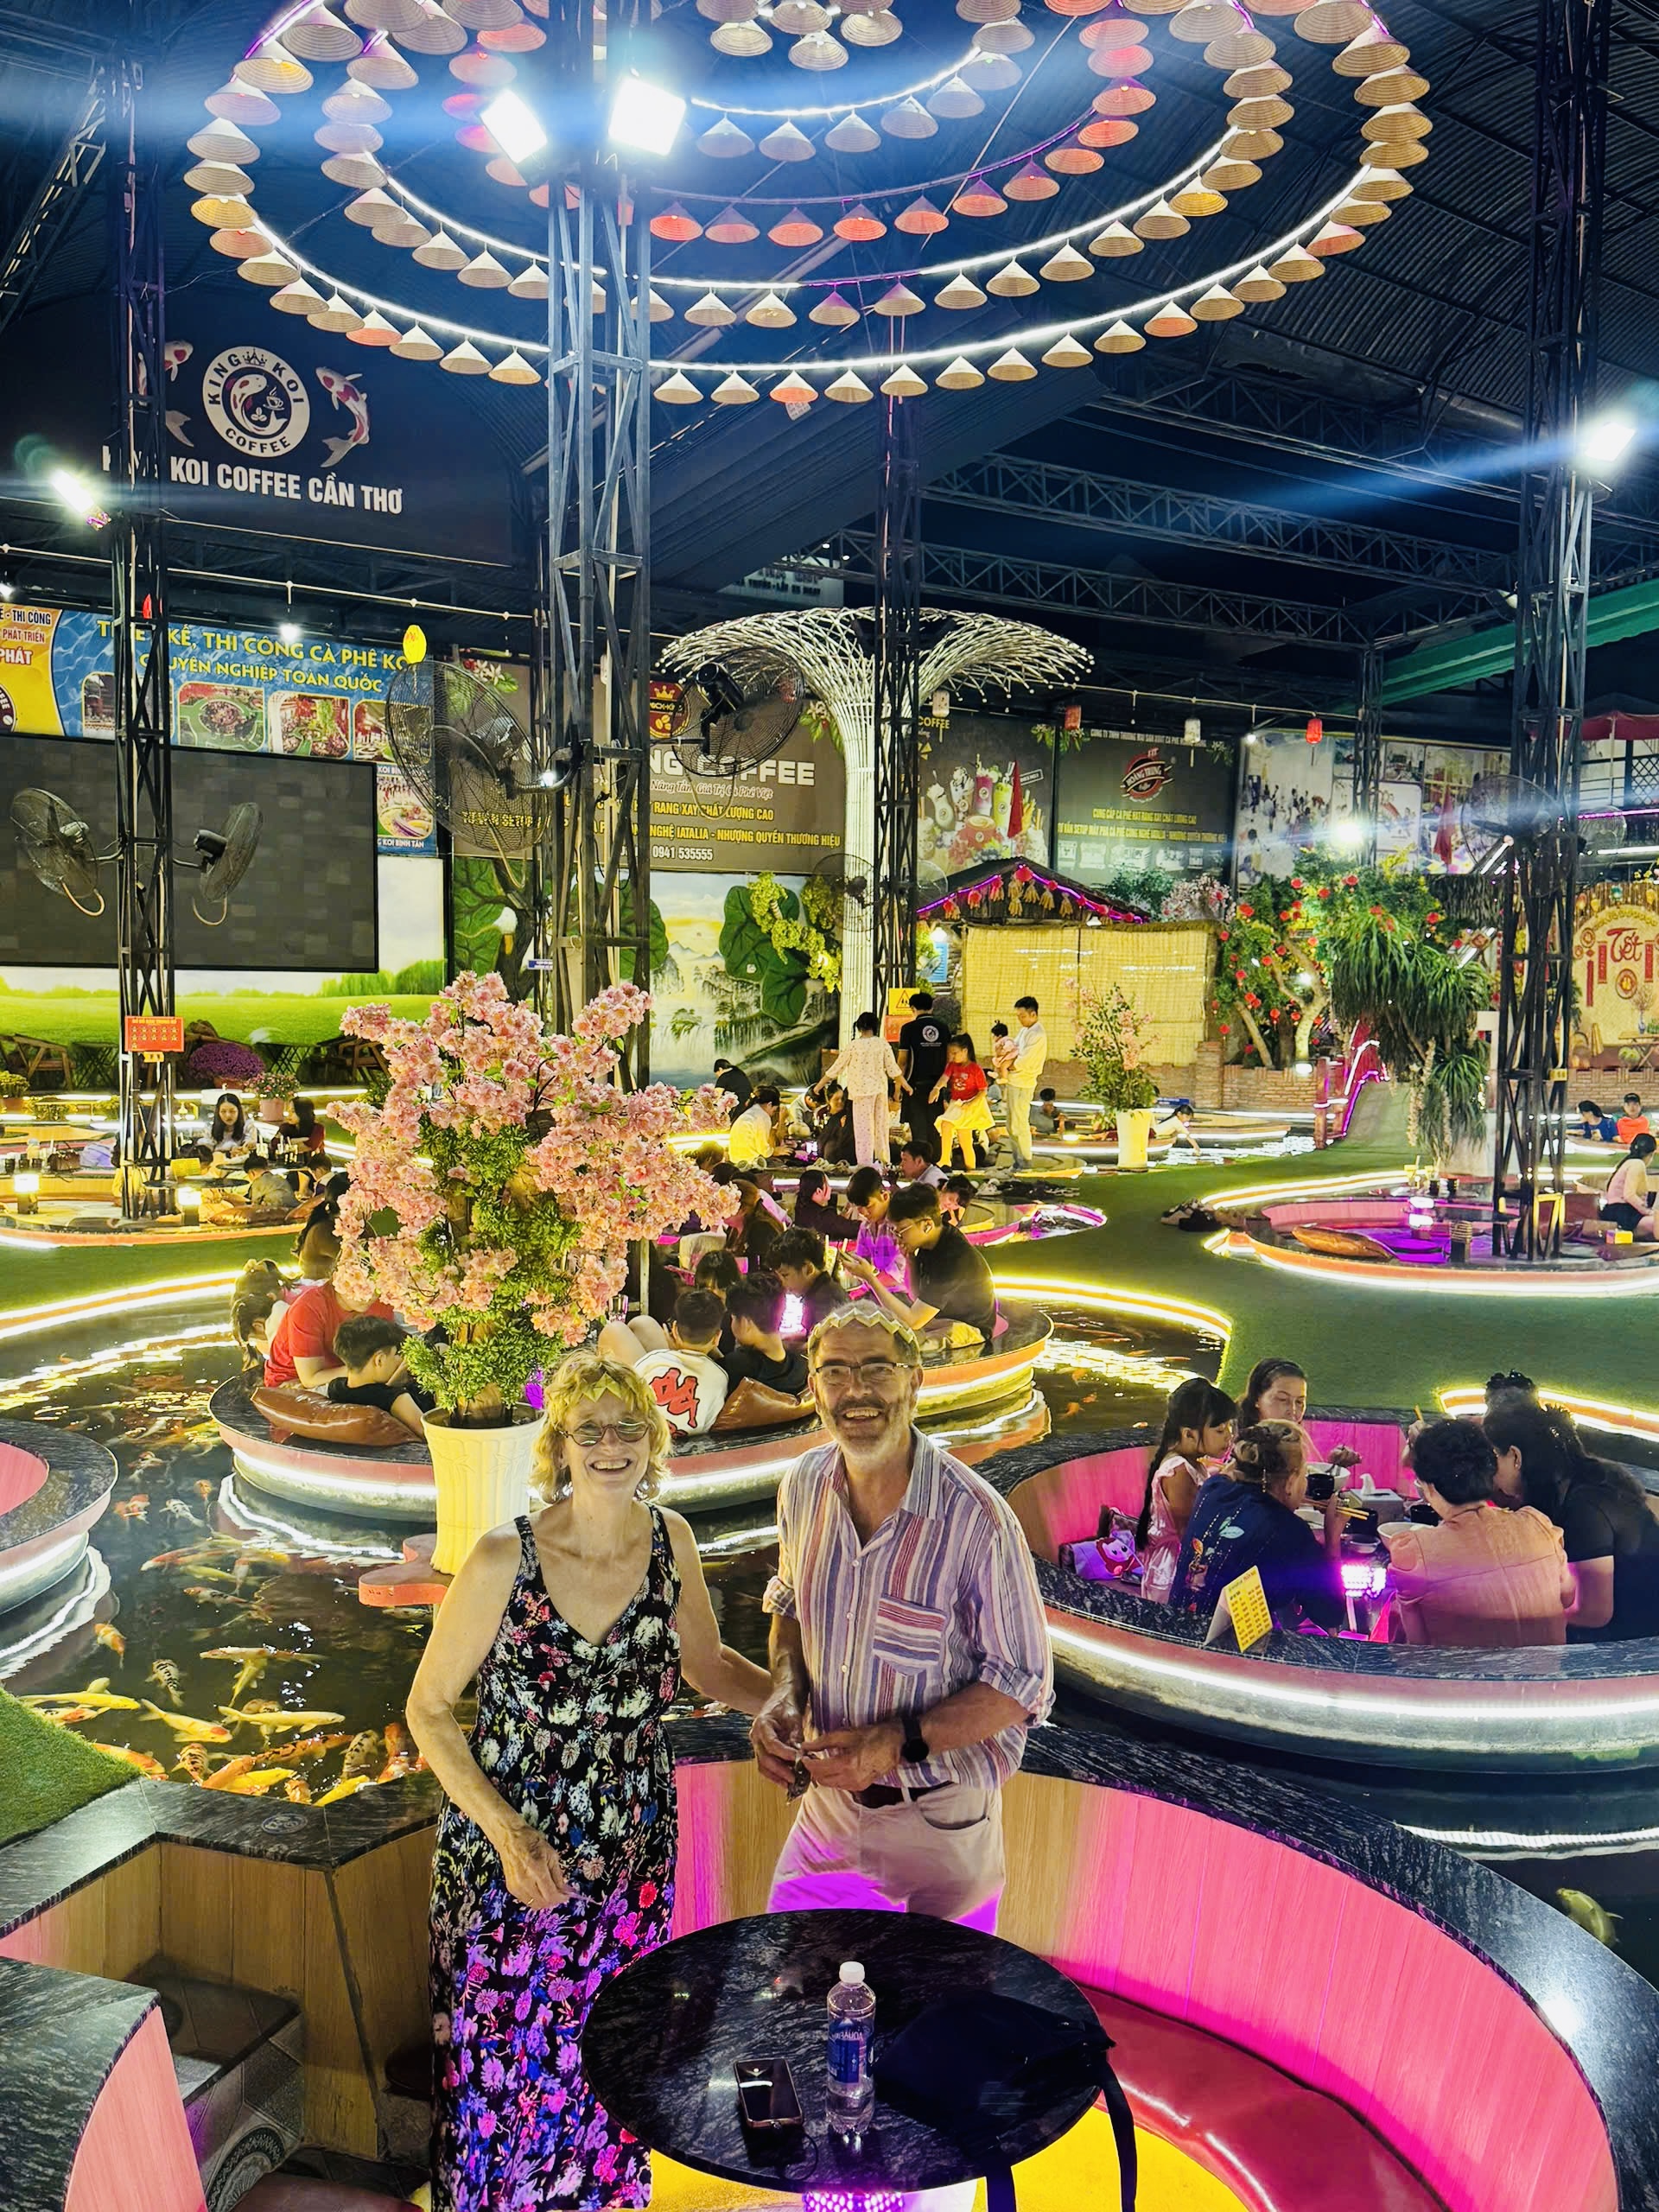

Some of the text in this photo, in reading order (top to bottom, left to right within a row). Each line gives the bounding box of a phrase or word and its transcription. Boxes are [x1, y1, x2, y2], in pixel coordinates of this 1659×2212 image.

[208, 353, 304, 405] KING KOI
[225, 428, 291, 454] COFFEE
[170, 456, 209, 486] KOI
[217, 463, 302, 499] COFFEE
[308, 472, 355, 508] CẦN
[360, 485, 403, 514] THƠ
[12, 609, 25, 622] THI
[28, 609, 51, 625] CÔNG
[203, 632, 238, 652] THI
[244, 636, 304, 659] CÔNG
[310, 645, 336, 664] CÀ
[341, 648, 377, 669] PHÊ
[139, 654, 383, 692] CUYÊN NGHIỆP TOÀN QUỐC
[654, 801, 680, 815] RANG
[681, 803, 698, 815] XAY
[756, 809, 774, 821] CAO
[677, 826, 709, 839] IATALIA
[652, 845, 675, 859] 0941
[677, 846, 714, 861] 535555
[1606, 927, 1643, 963] Tết
